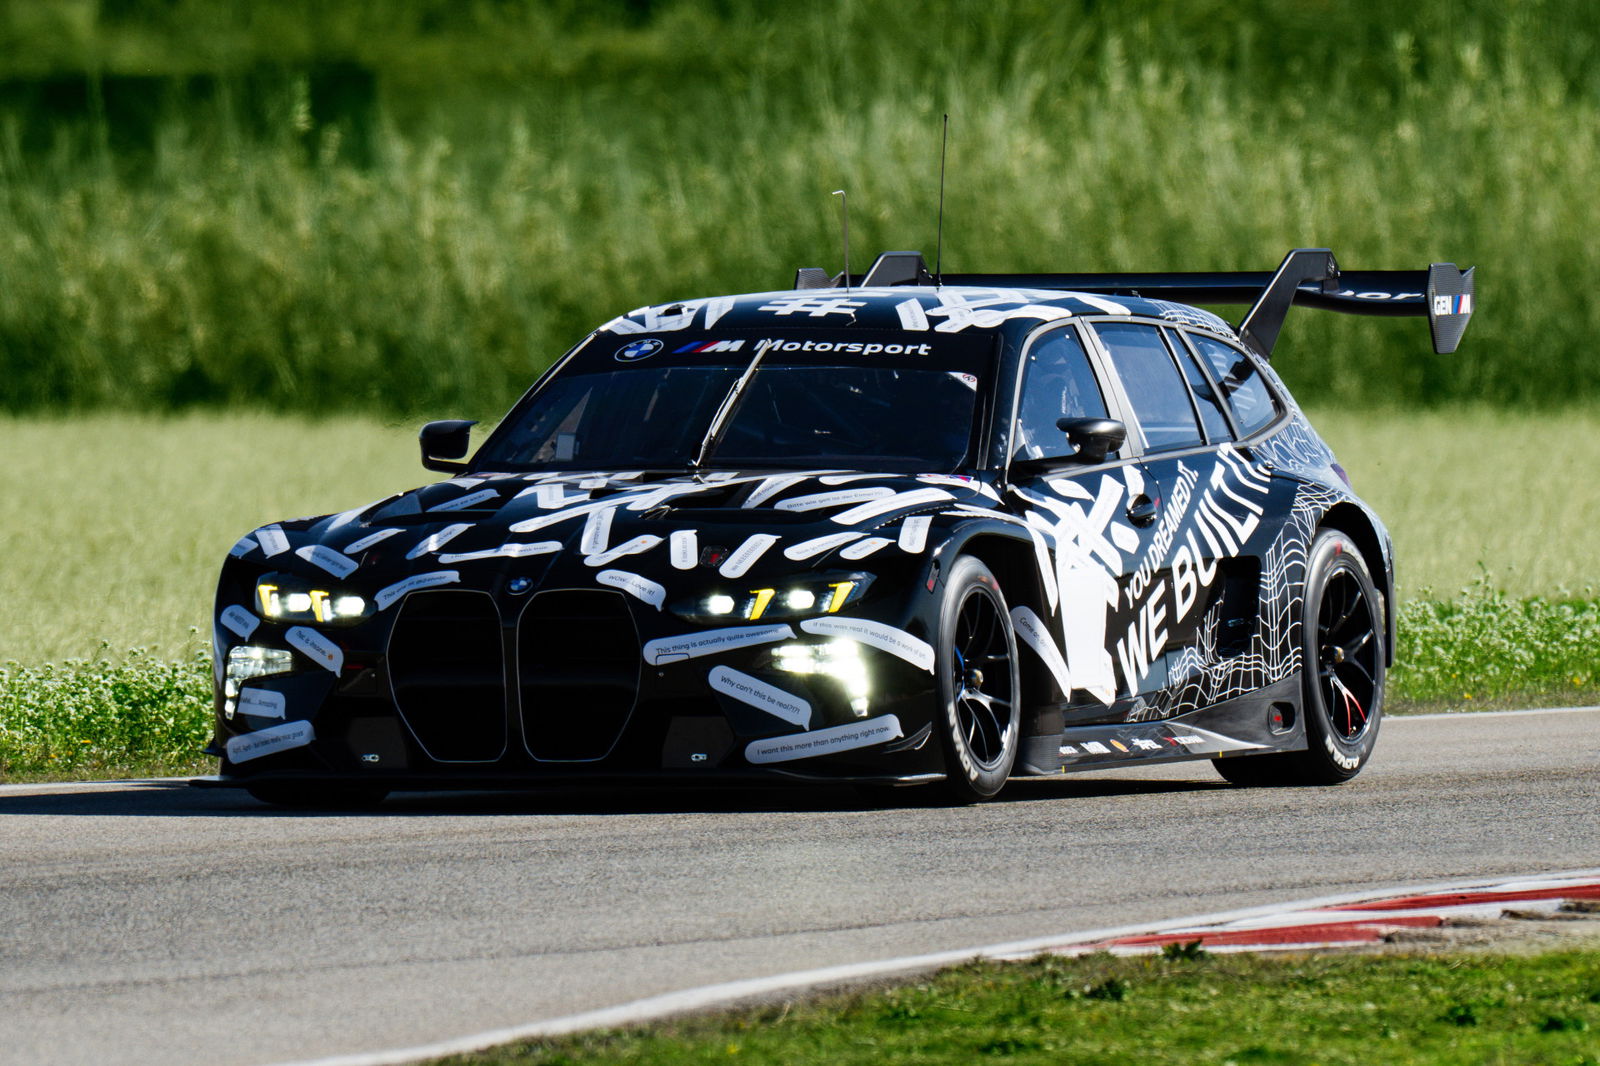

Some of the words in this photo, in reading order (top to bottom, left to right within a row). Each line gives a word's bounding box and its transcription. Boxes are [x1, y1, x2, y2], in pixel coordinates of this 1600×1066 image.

[1434, 295, 1452, 316] GEN
[753, 339, 932, 356] Motorsport
[1124, 556, 1151, 610] YOU
[1148, 476, 1191, 574] DREAMED
[1177, 459, 1199, 490] IT.
[1116, 580, 1169, 698] WE
[1171, 460, 1264, 625] BUILT
[849, 625, 863, 633] real
[869, 630, 888, 642] would
[888, 636, 897, 645] be
[1019, 616, 1034, 633] Come
[656, 647, 671, 655] This
[672, 642, 690, 652] thing
[691, 640, 697, 648] is
[698, 636, 726, 648] actually
[726, 633, 745, 643] quite
[720, 675, 736, 688] Why
[736, 682, 753, 696] can't
[754, 689, 767, 702] this
[767, 695, 776, 706] be
[761, 747, 779, 755] want
[780, 743, 794, 752] this
[794, 741, 812, 750] more
[813, 738, 830, 747] than
[830, 733, 859, 746] anything
[859, 729, 875, 741] right
